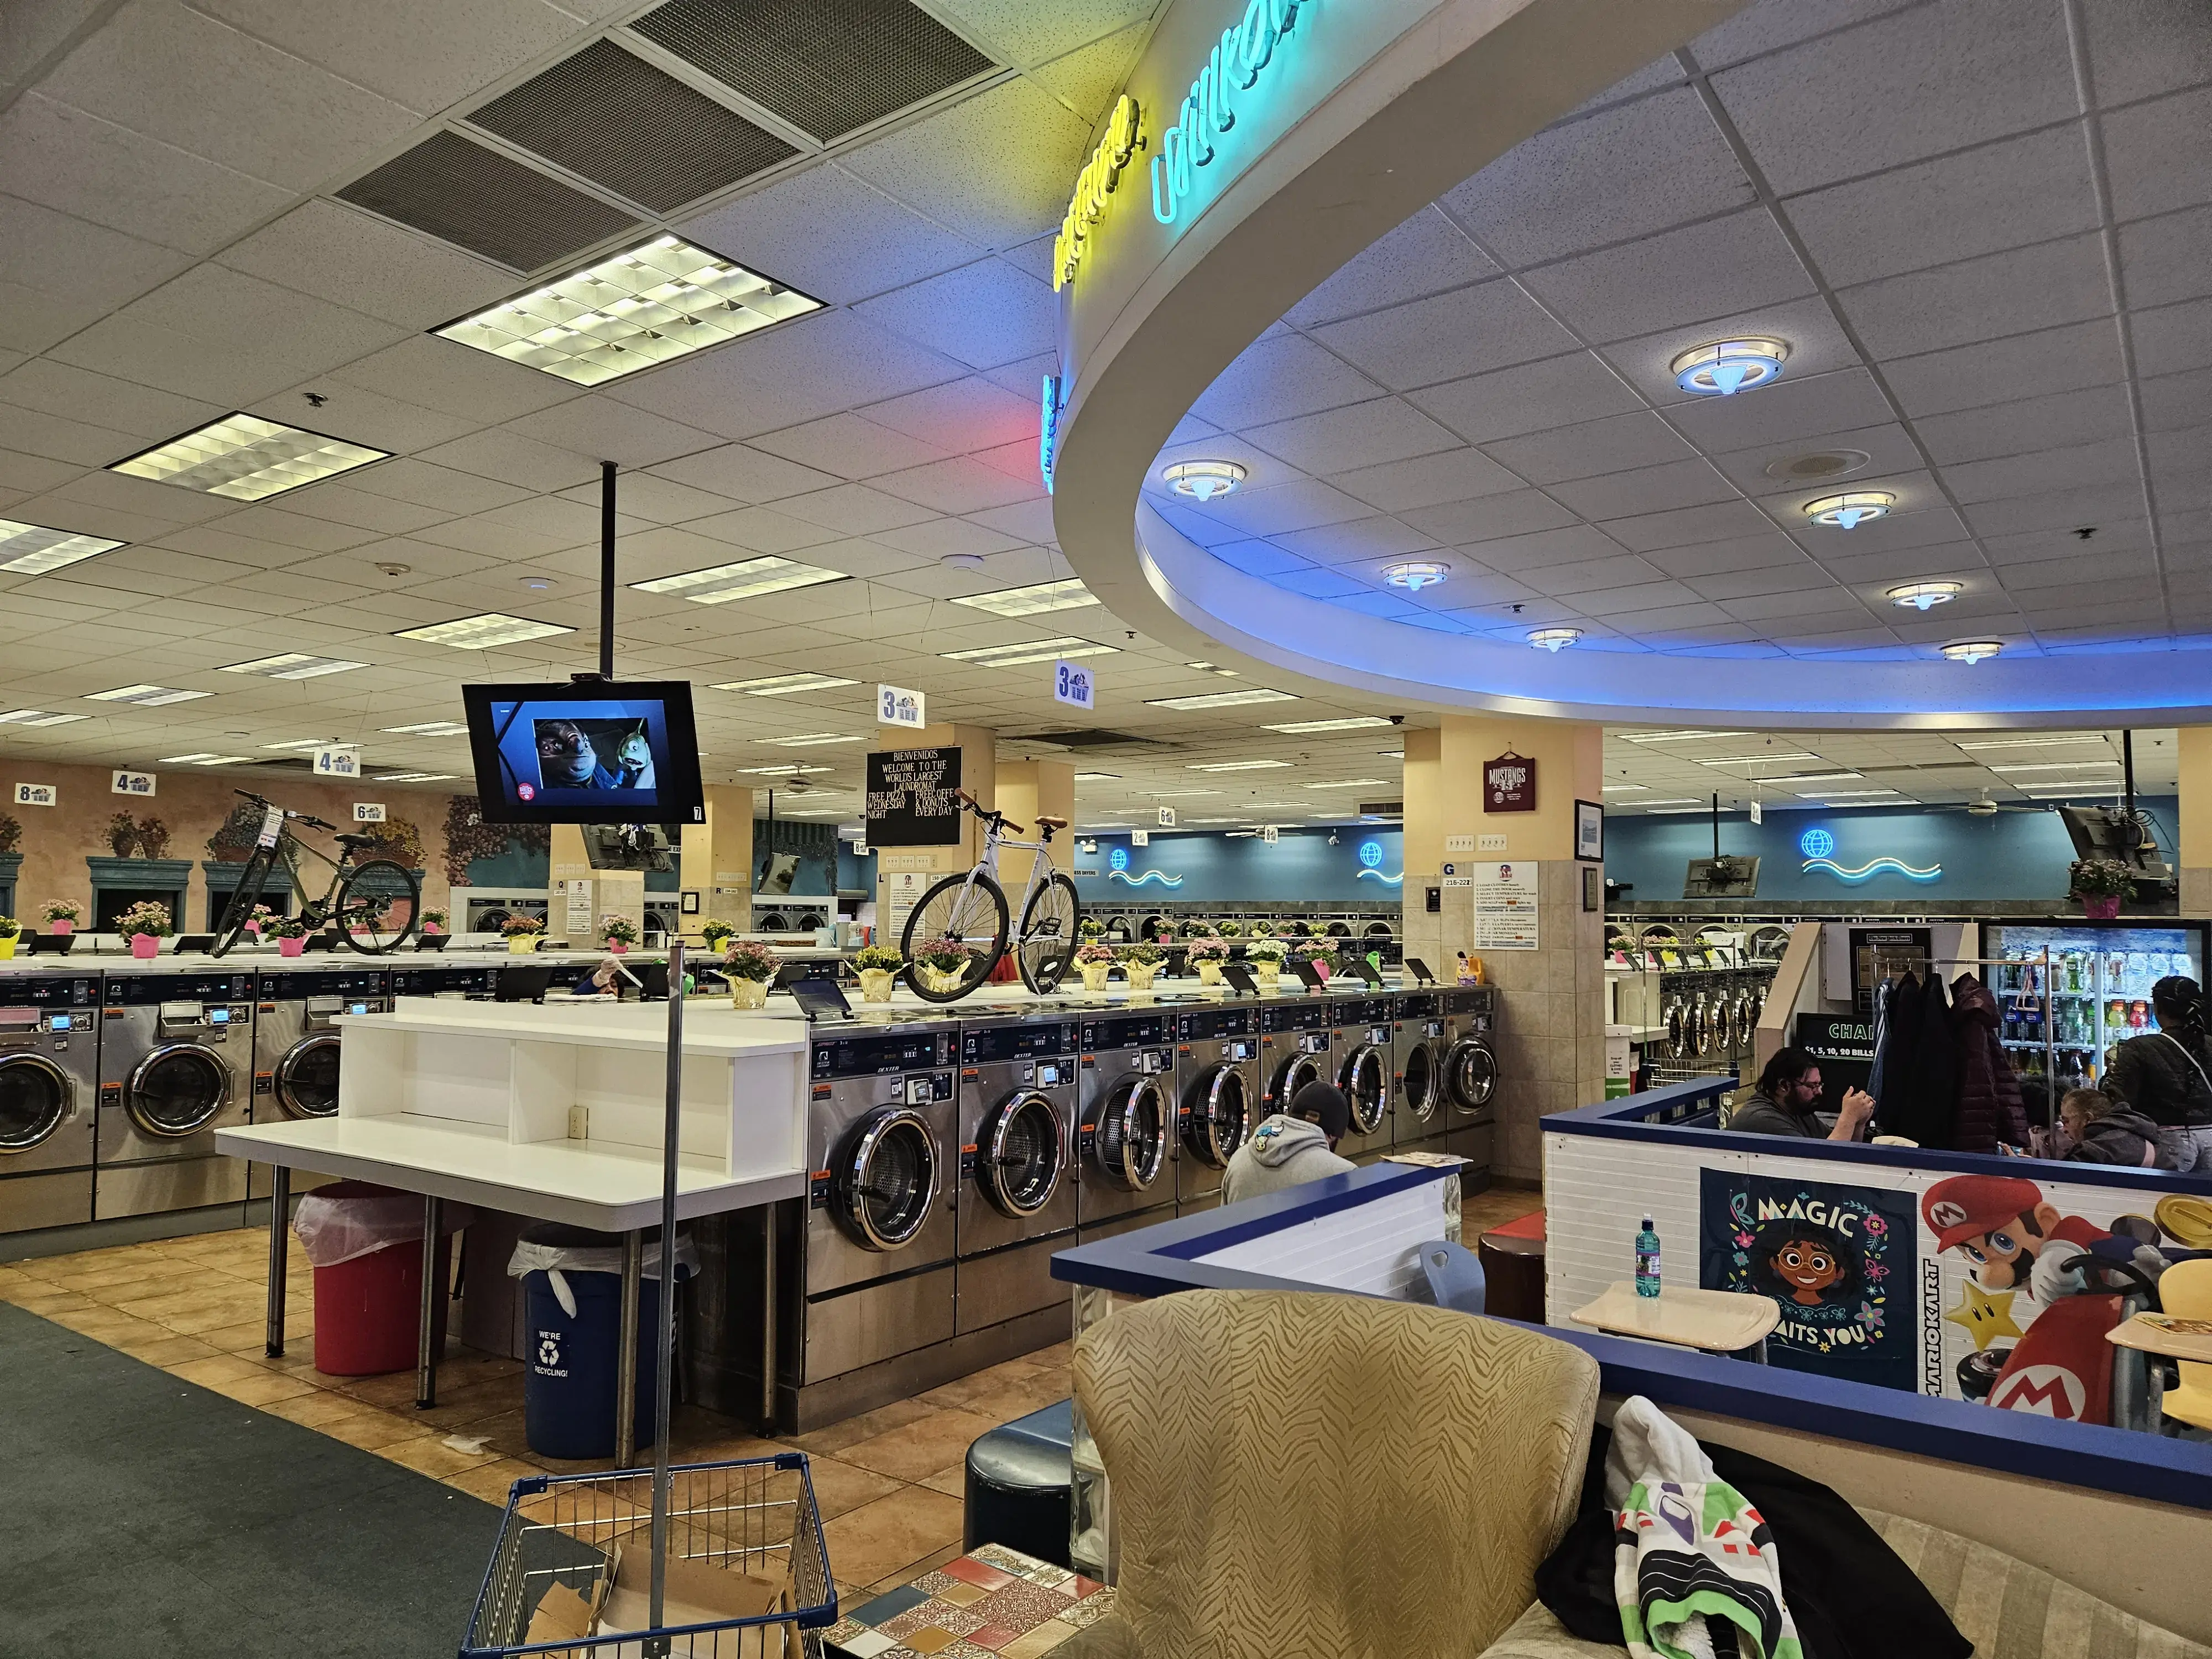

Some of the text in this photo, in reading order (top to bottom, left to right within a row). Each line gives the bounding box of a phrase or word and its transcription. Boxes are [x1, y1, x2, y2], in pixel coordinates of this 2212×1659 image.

[1059, 666, 1069, 697] 3
[883, 691, 895, 719] 3
[894, 749, 938, 761] BIENVENIDOS
[320, 753, 331, 771] 4
[882, 760, 947, 773] WELCOME TO THE
[914, 771, 943, 781] LARGEST
[1489, 768, 1526, 784] MUSTANGS
[117, 774, 128, 791] 4
[894, 780, 936, 792] LAUNDROMAT
[20, 786, 30, 801] 8
[868, 791, 906, 801] FREE PIZZA
[867, 799, 906, 810] WEDNESDAY
[915, 797, 948, 807] & DONUTS
[358, 806, 365, 818] 6
[695, 807, 701, 820] 7
[867, 810, 886, 819] NIGHT
[915, 806, 953, 817] EVERY DAY
[1161, 810, 1165, 822] 6
[1134, 833, 1138, 843] 2
[1266, 829, 1270, 841] 8
[855, 843, 859, 853] 8
[1444, 864, 1454, 875] G
[879, 874, 884, 883] L
[1818, 1047, 1825, 1056] 5,
[1827, 1047, 1838, 1056] 10,
[1758, 1197, 1858, 1238] MAGIC
[1934, 1203, 1965, 1227] M
[539, 1330, 561, 1340] WE'RE
[1823, 1325, 1865, 1345] YOU
[535, 1365, 568, 1377] RECYCLING!
[1997, 1374, 2075, 1420] M
